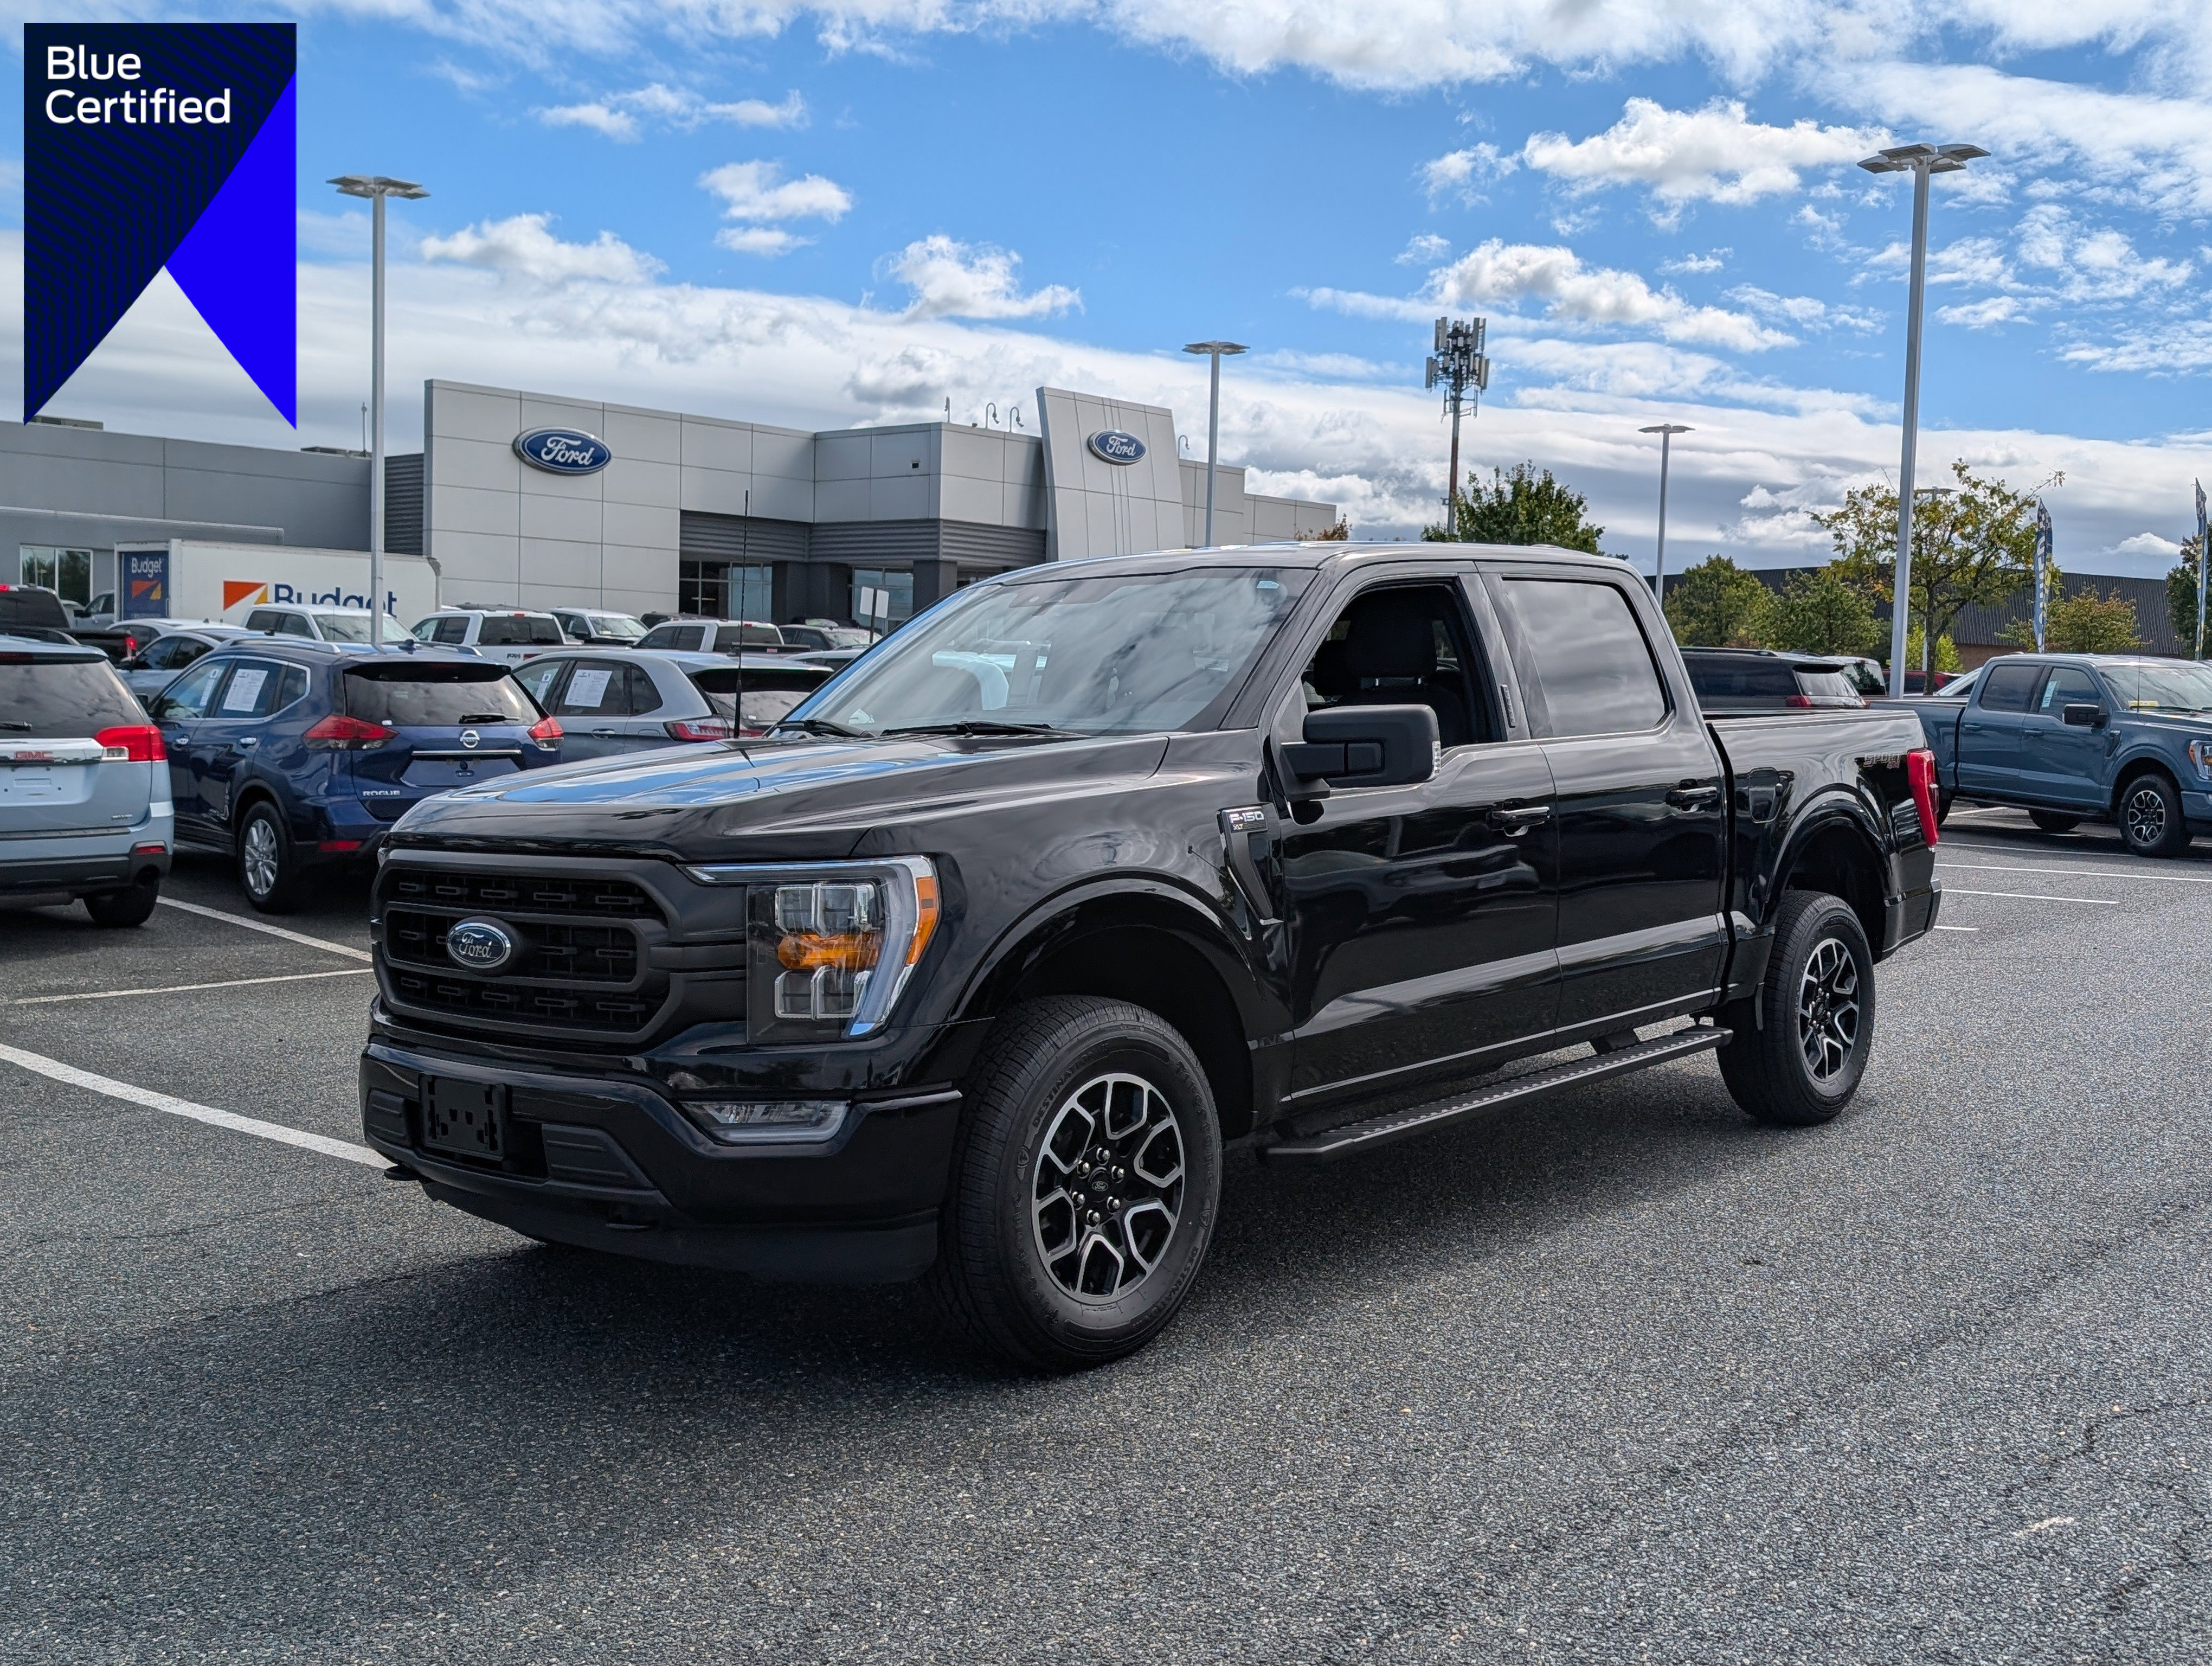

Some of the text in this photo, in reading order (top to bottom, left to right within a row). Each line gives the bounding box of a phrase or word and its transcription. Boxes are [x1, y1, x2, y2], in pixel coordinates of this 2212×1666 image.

[541, 436, 595, 465] Ford
[1107, 435, 1136, 456] Ford
[131, 557, 162, 578] Budget
[274, 583, 397, 619] Budt
[14, 751, 54, 761] GMC
[459, 932, 492, 958] Ford
